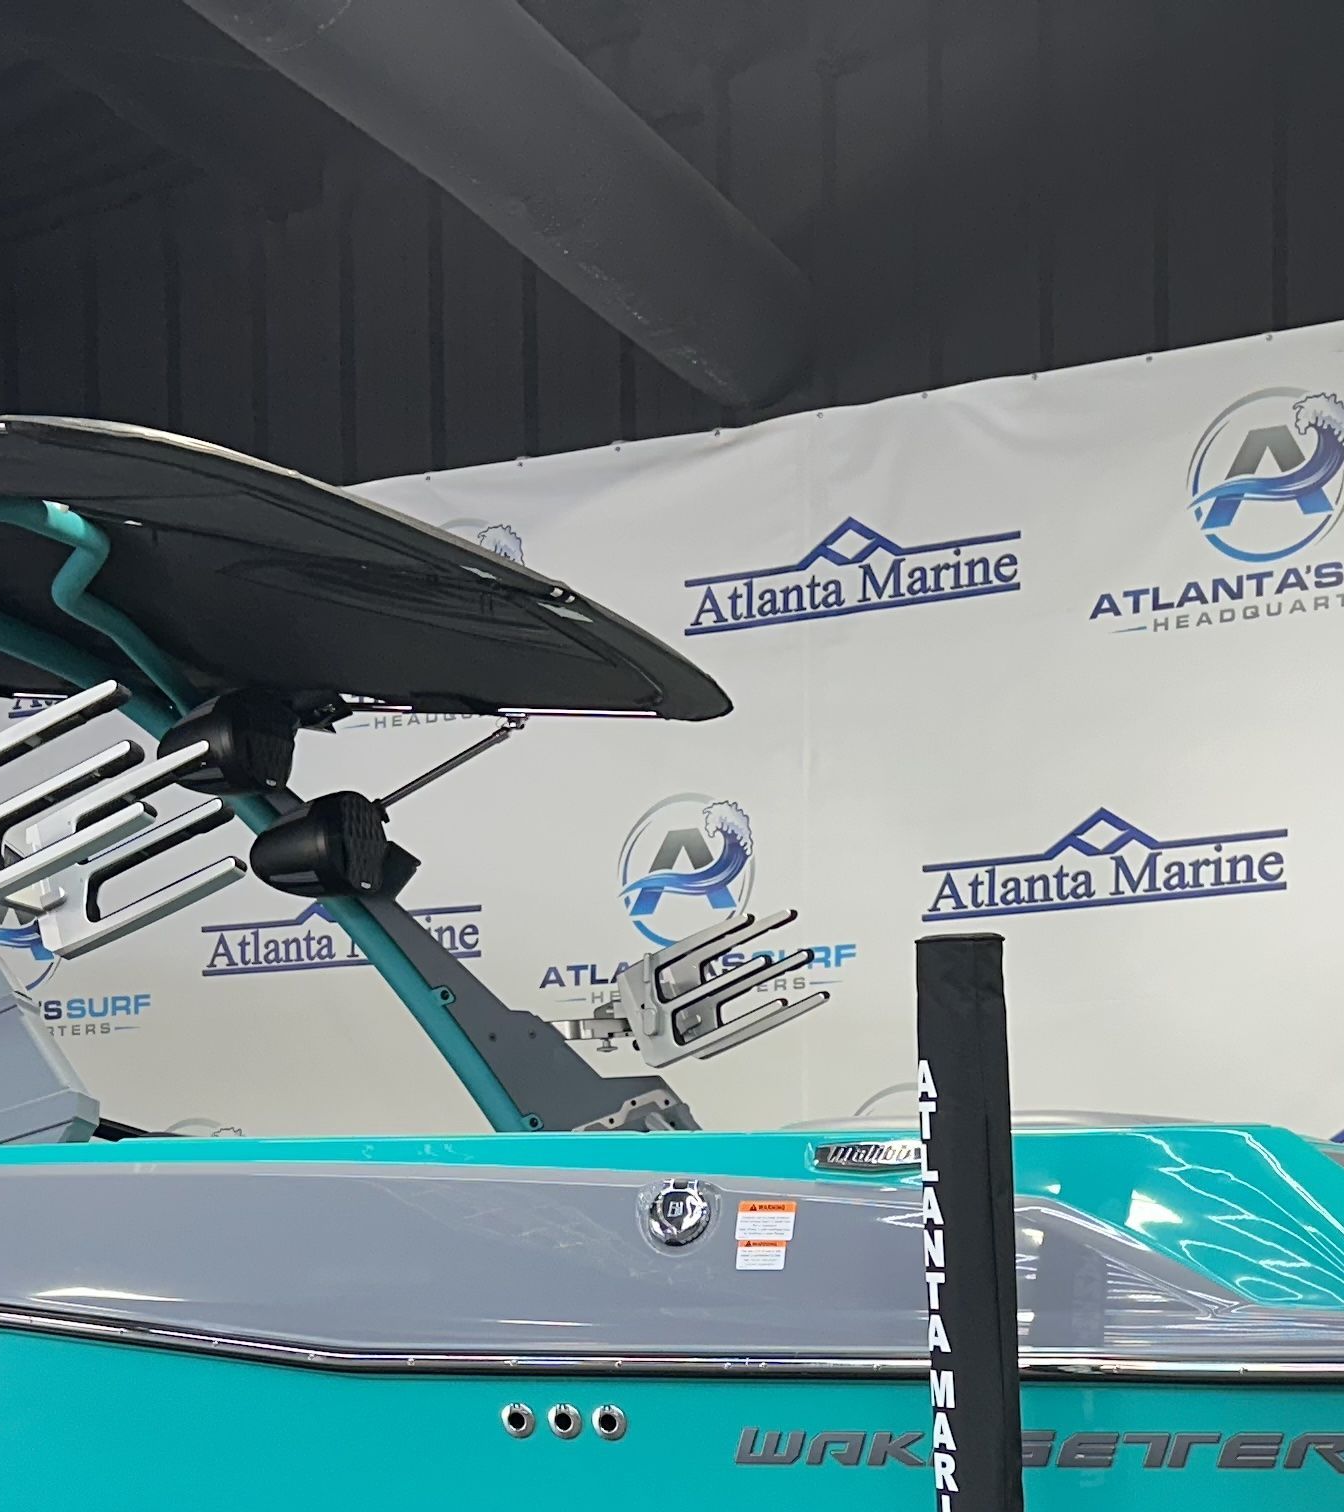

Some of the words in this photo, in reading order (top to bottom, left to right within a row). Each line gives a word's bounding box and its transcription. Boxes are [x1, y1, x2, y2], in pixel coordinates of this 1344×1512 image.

[690, 575, 846, 626] Atlanta
[857, 549, 1018, 602] Marine
[928, 865, 1095, 912] Atlanta
[1109, 844, 1284, 896] Marine
[206, 929, 336, 967] Atlanta
[917, 1060, 952, 1353] ATLANTA
